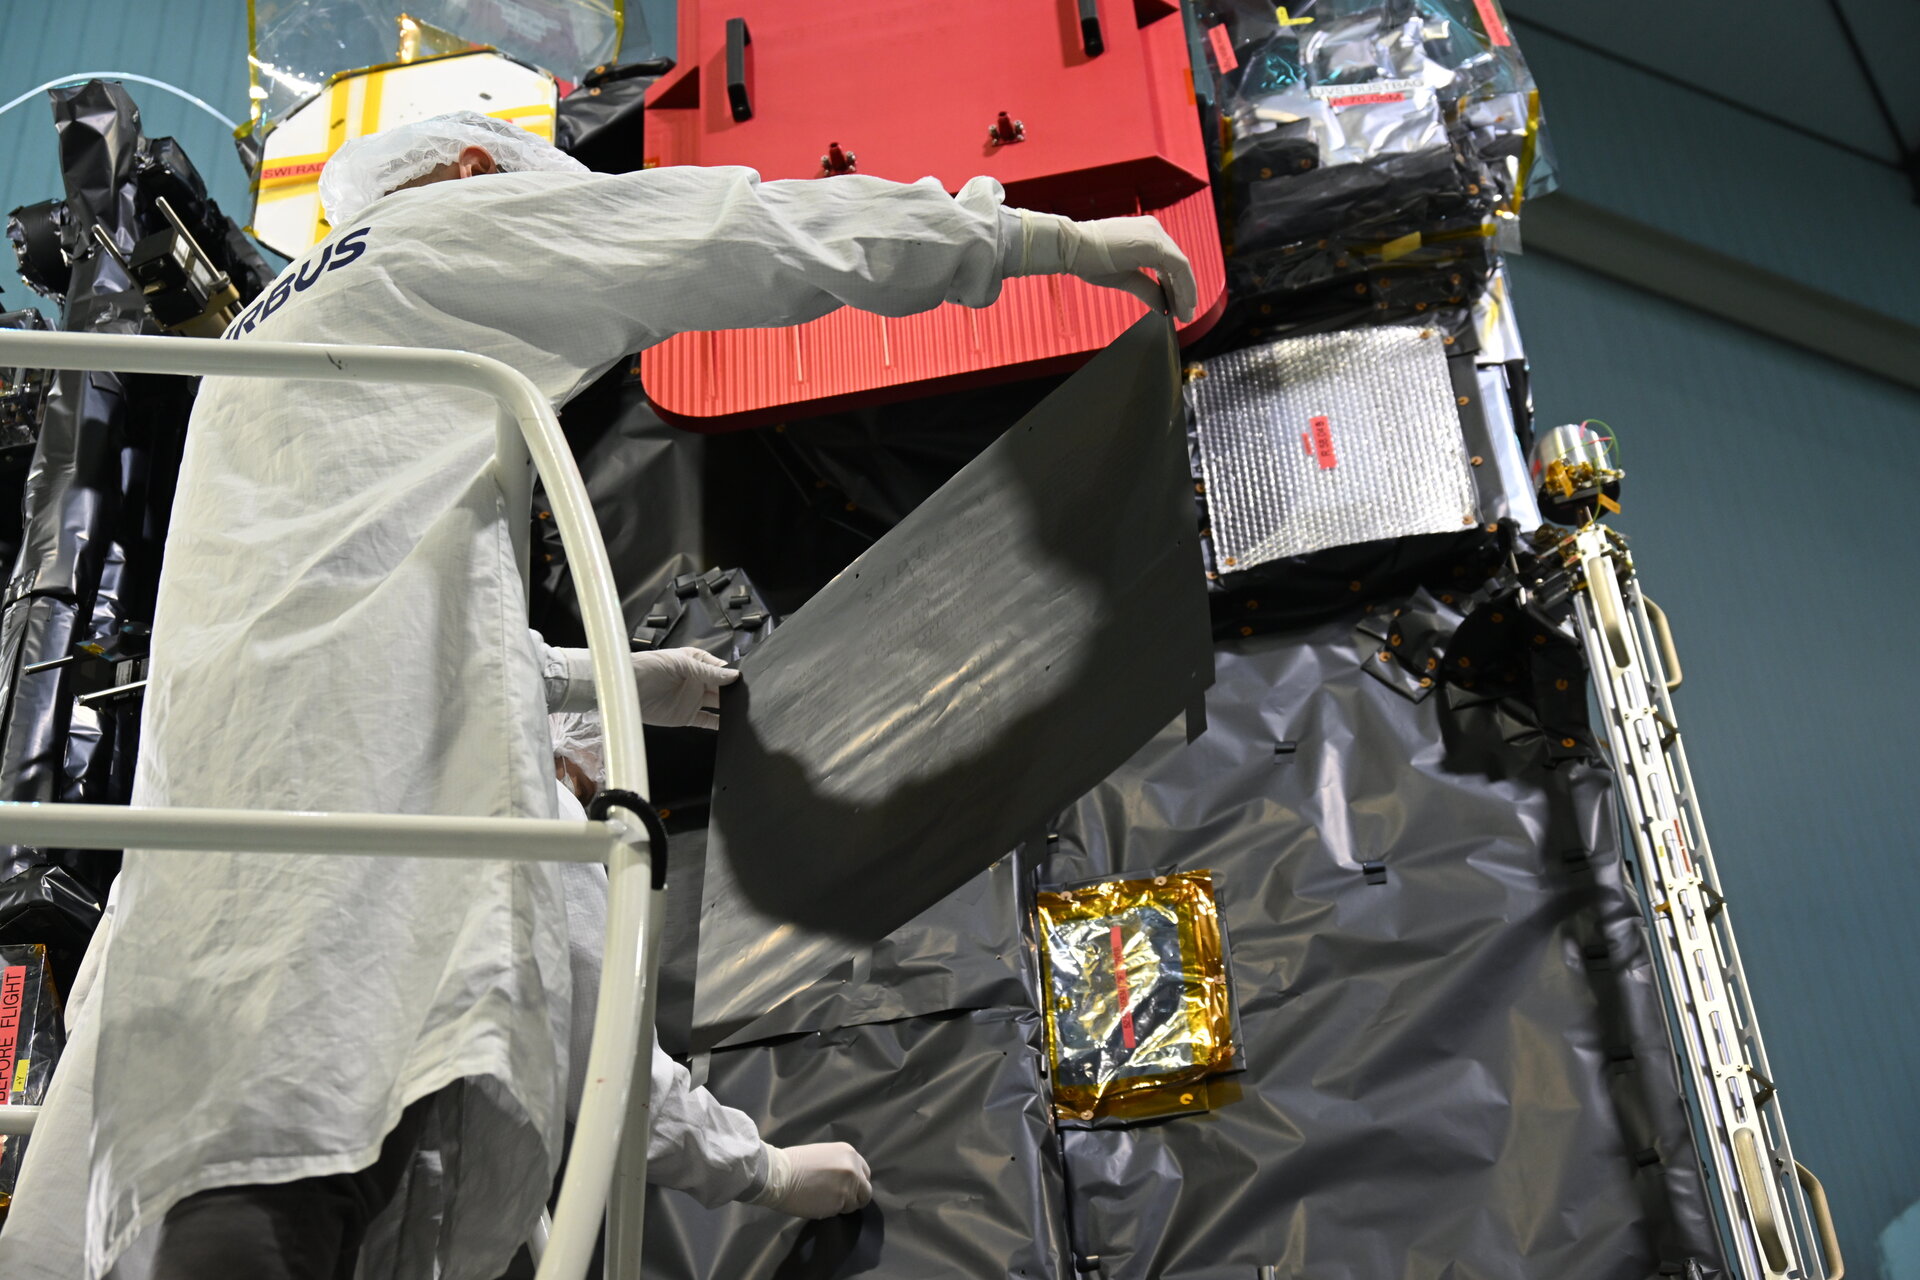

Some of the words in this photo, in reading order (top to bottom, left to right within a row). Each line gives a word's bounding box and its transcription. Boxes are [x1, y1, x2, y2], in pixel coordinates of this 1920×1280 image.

[1314, 86, 1345, 96] UVS
[1350, 79, 1424, 93] DUSTBAG
[264, 167, 291, 179] SWI
[1, 973, 22, 1028] FLIGHT
